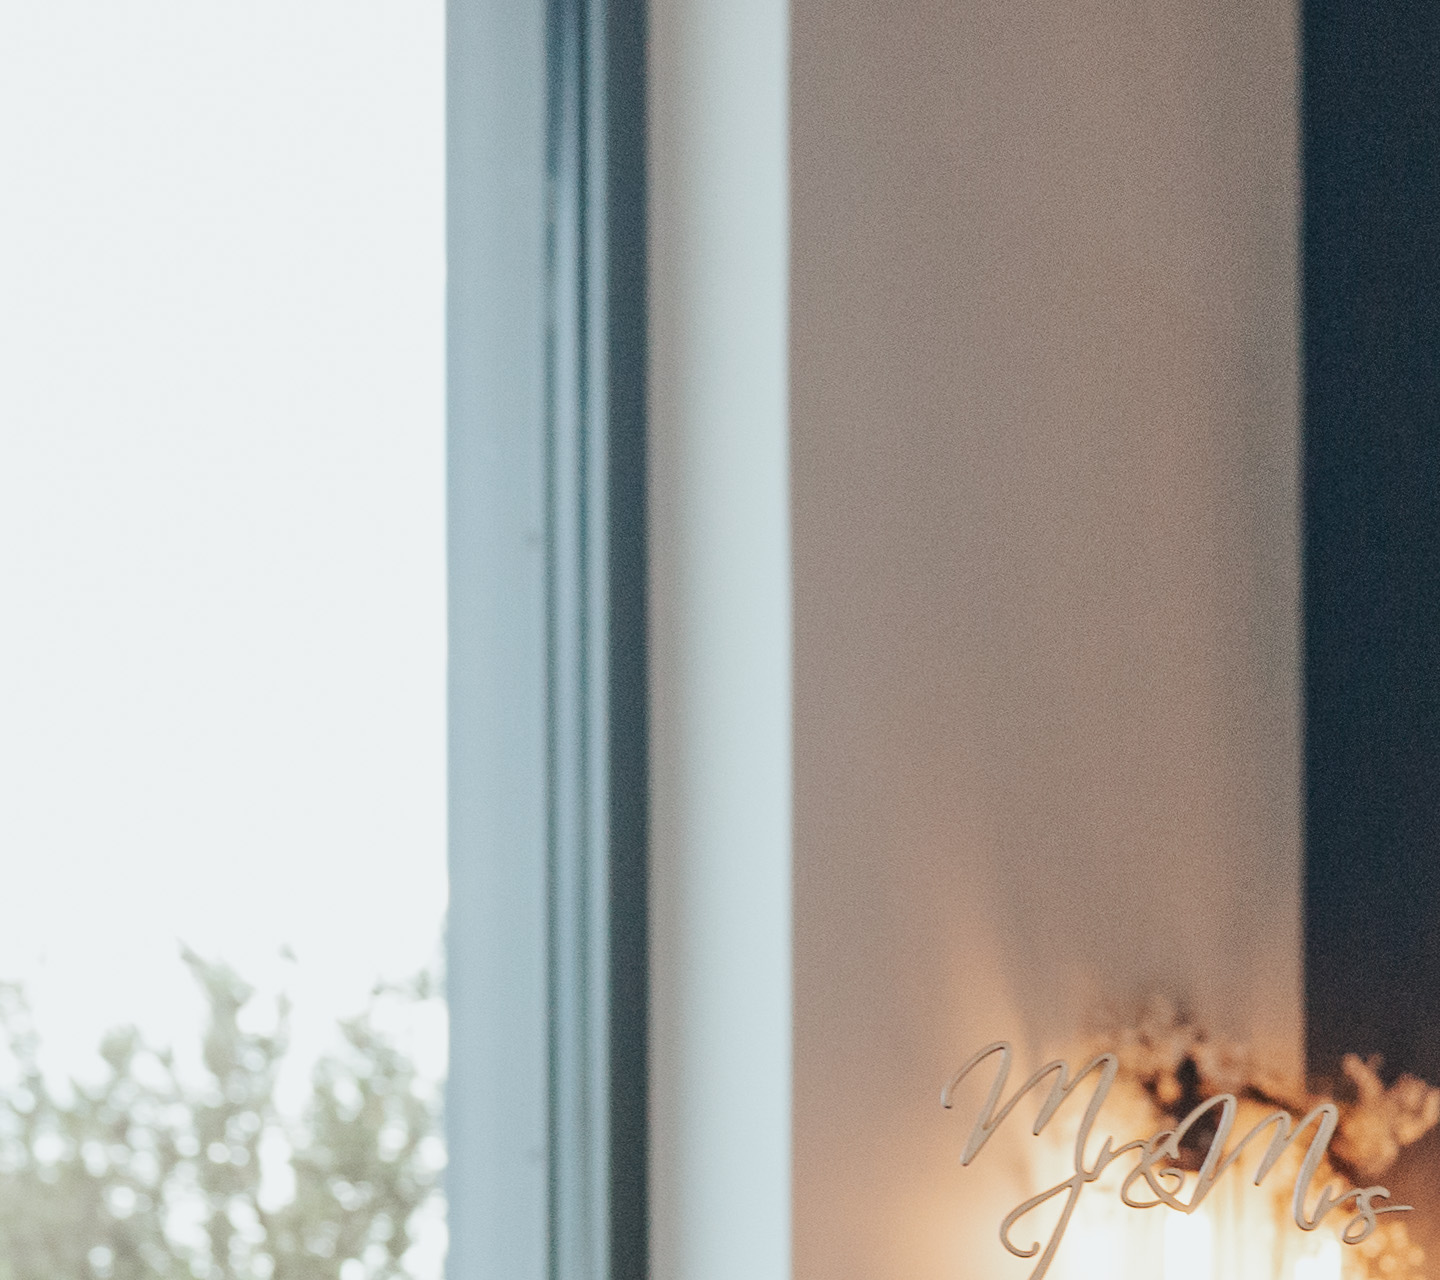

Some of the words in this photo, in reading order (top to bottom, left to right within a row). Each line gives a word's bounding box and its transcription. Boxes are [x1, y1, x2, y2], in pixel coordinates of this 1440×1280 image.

[941, 1040, 1148, 1182] Mr
[1121, 1129, 1186, 1209] &
[1170, 1093, 1415, 1245] Mrs
